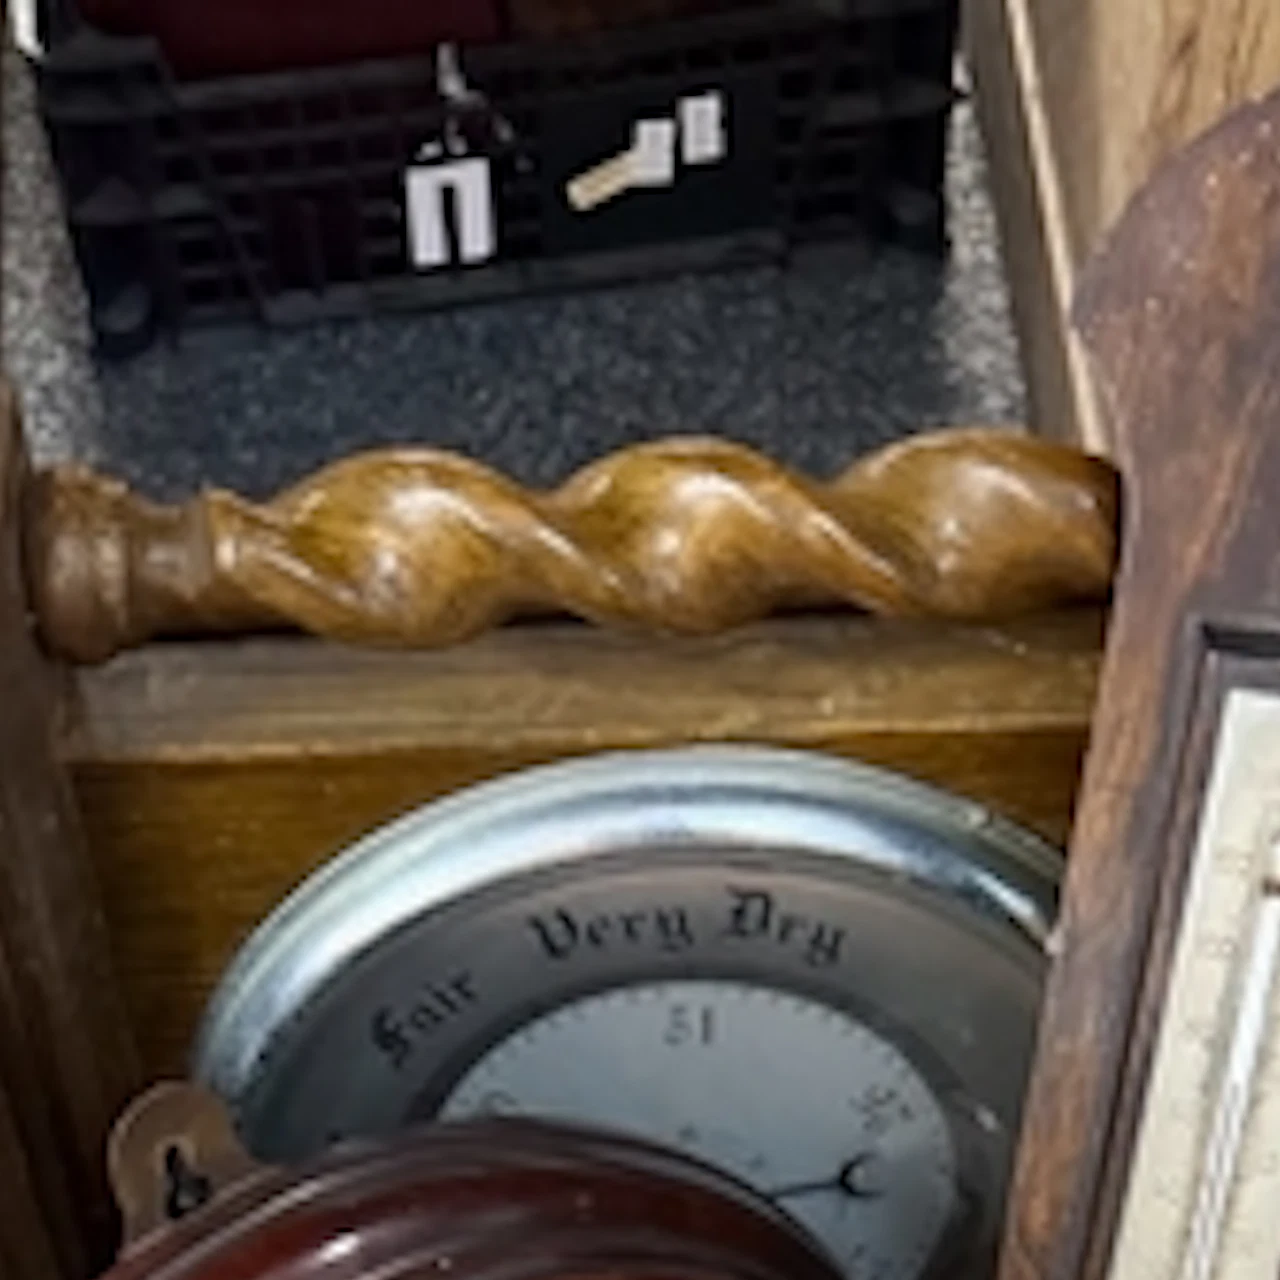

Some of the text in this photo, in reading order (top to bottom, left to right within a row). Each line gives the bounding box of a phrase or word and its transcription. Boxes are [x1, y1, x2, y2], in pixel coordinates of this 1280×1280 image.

[528, 885, 848, 970] Very Dry
[372, 968, 484, 1072] Fair
